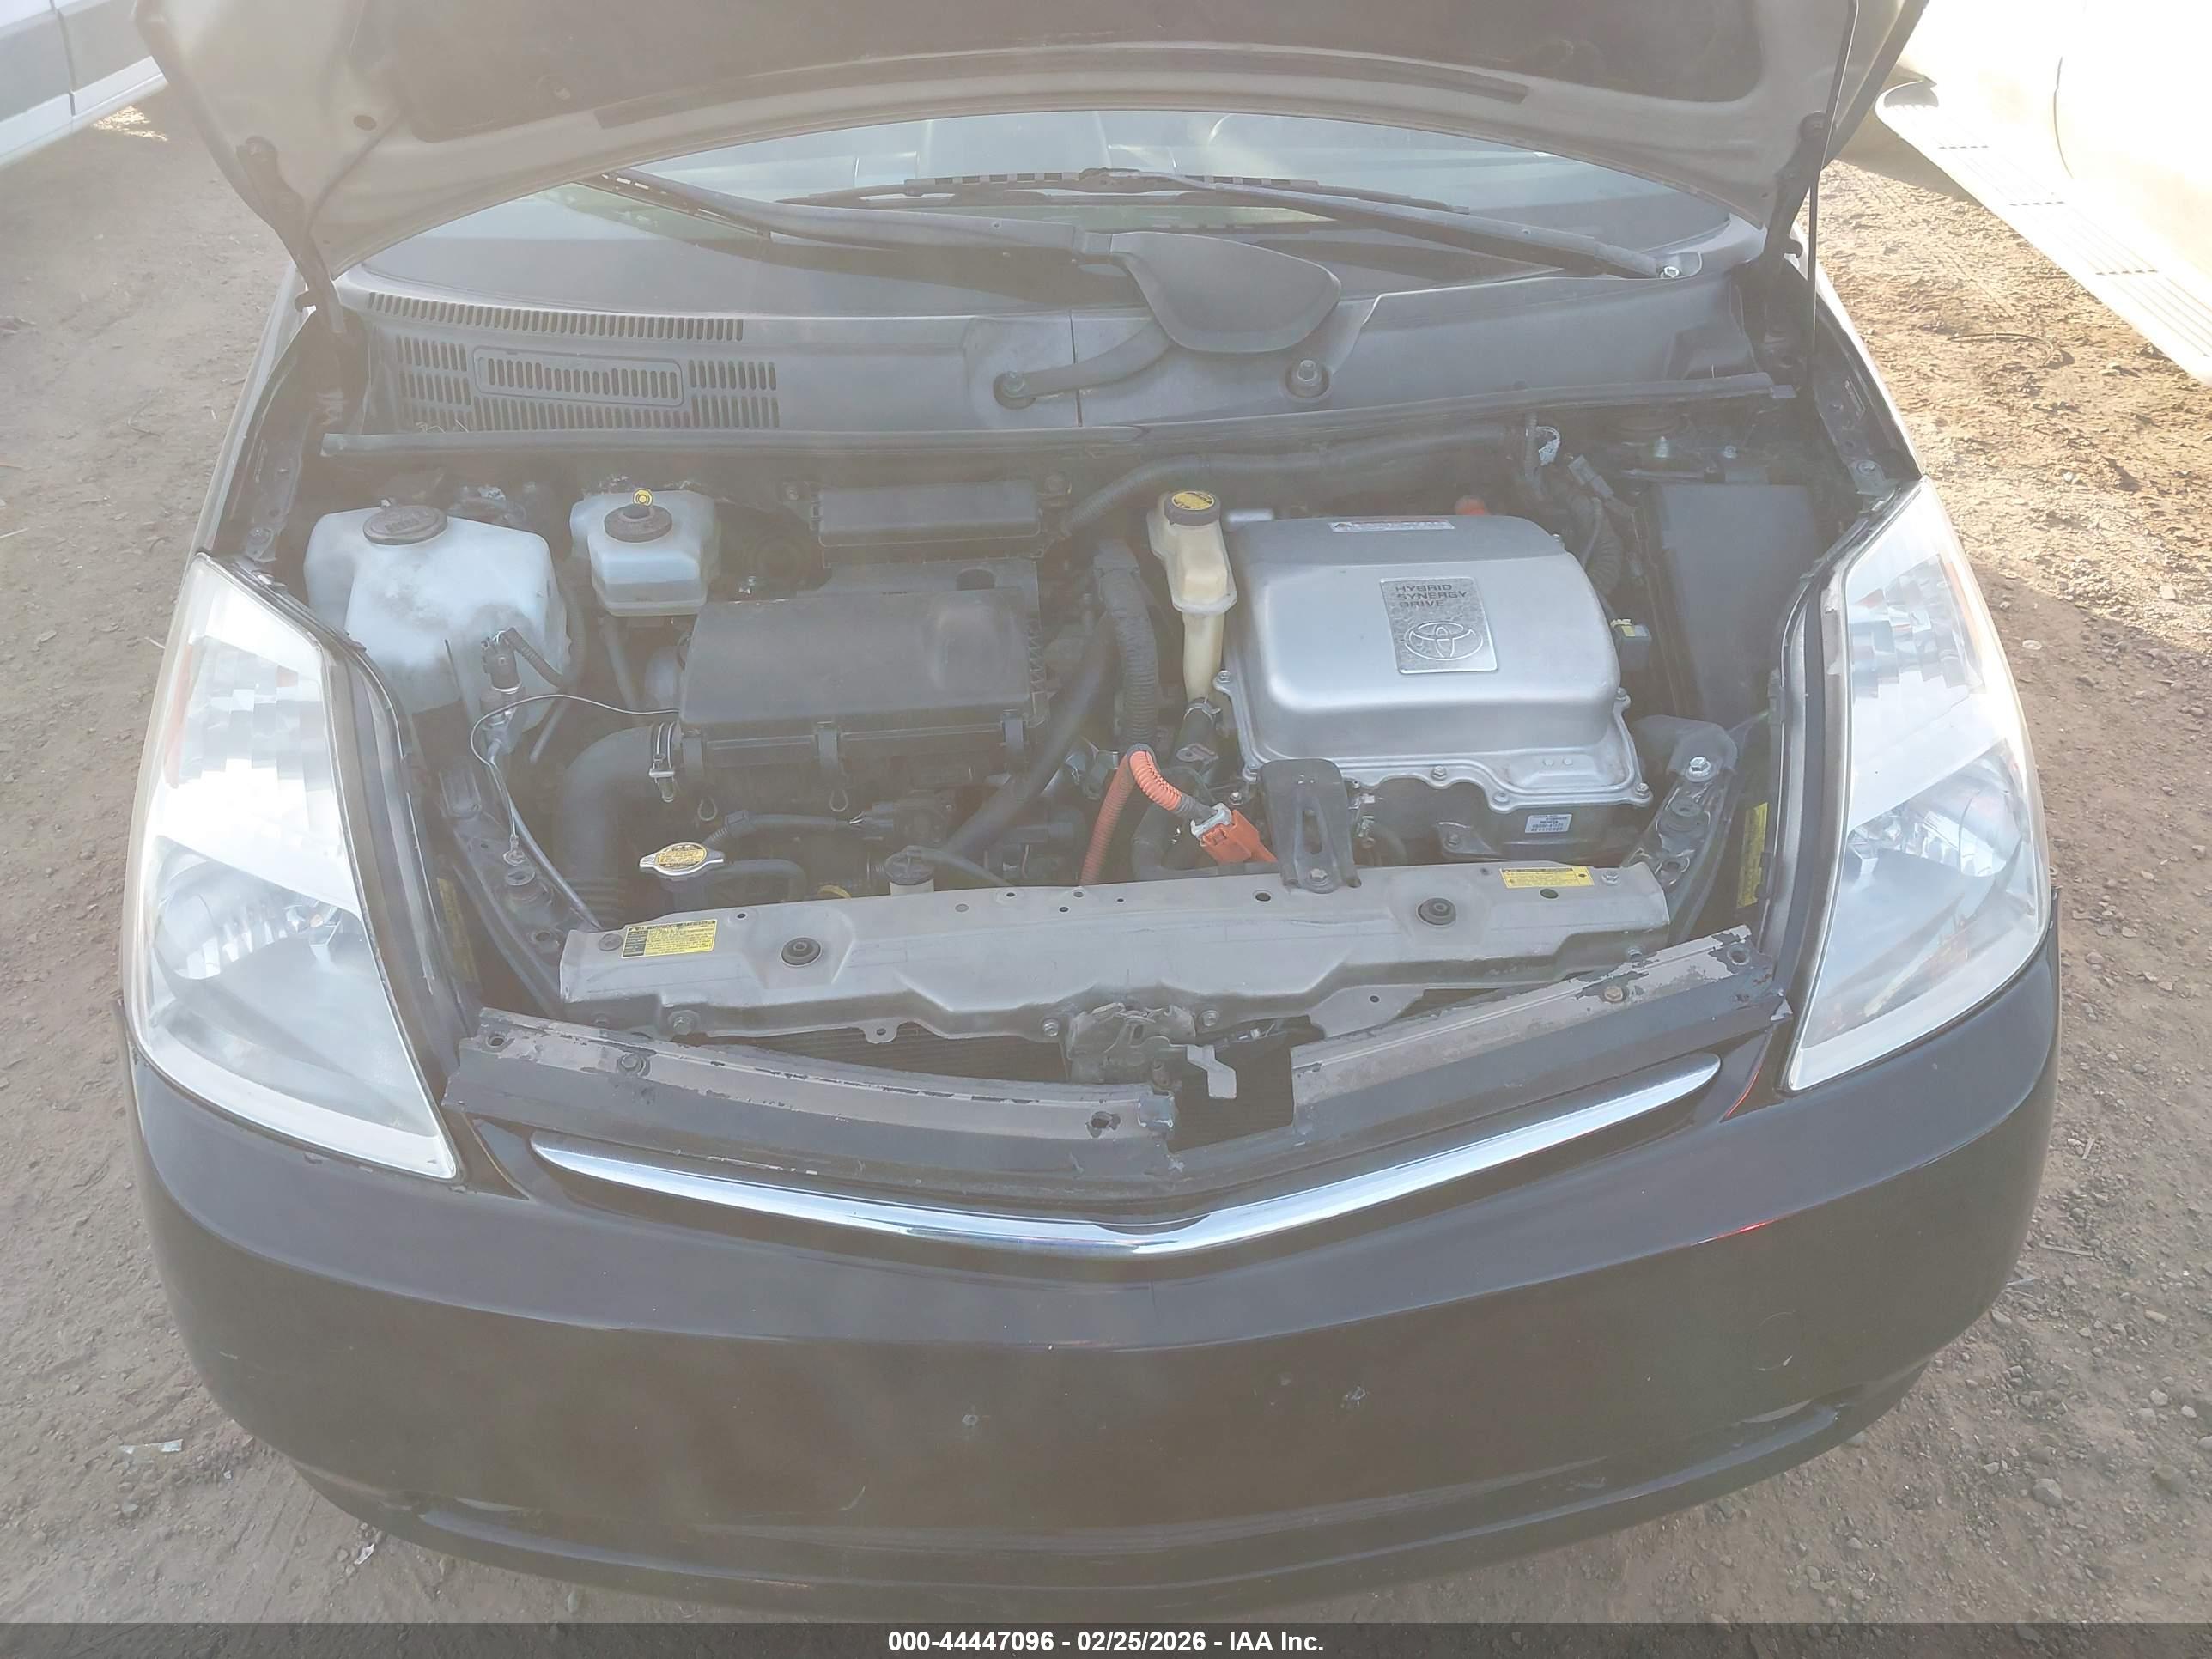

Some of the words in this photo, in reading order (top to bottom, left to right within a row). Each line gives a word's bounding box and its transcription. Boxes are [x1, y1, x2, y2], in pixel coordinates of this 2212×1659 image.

[1395, 584, 1453, 592] HYBRID
[1396, 591, 1468, 600] SYNERGY
[1399, 599, 1444, 608] DRIVE
